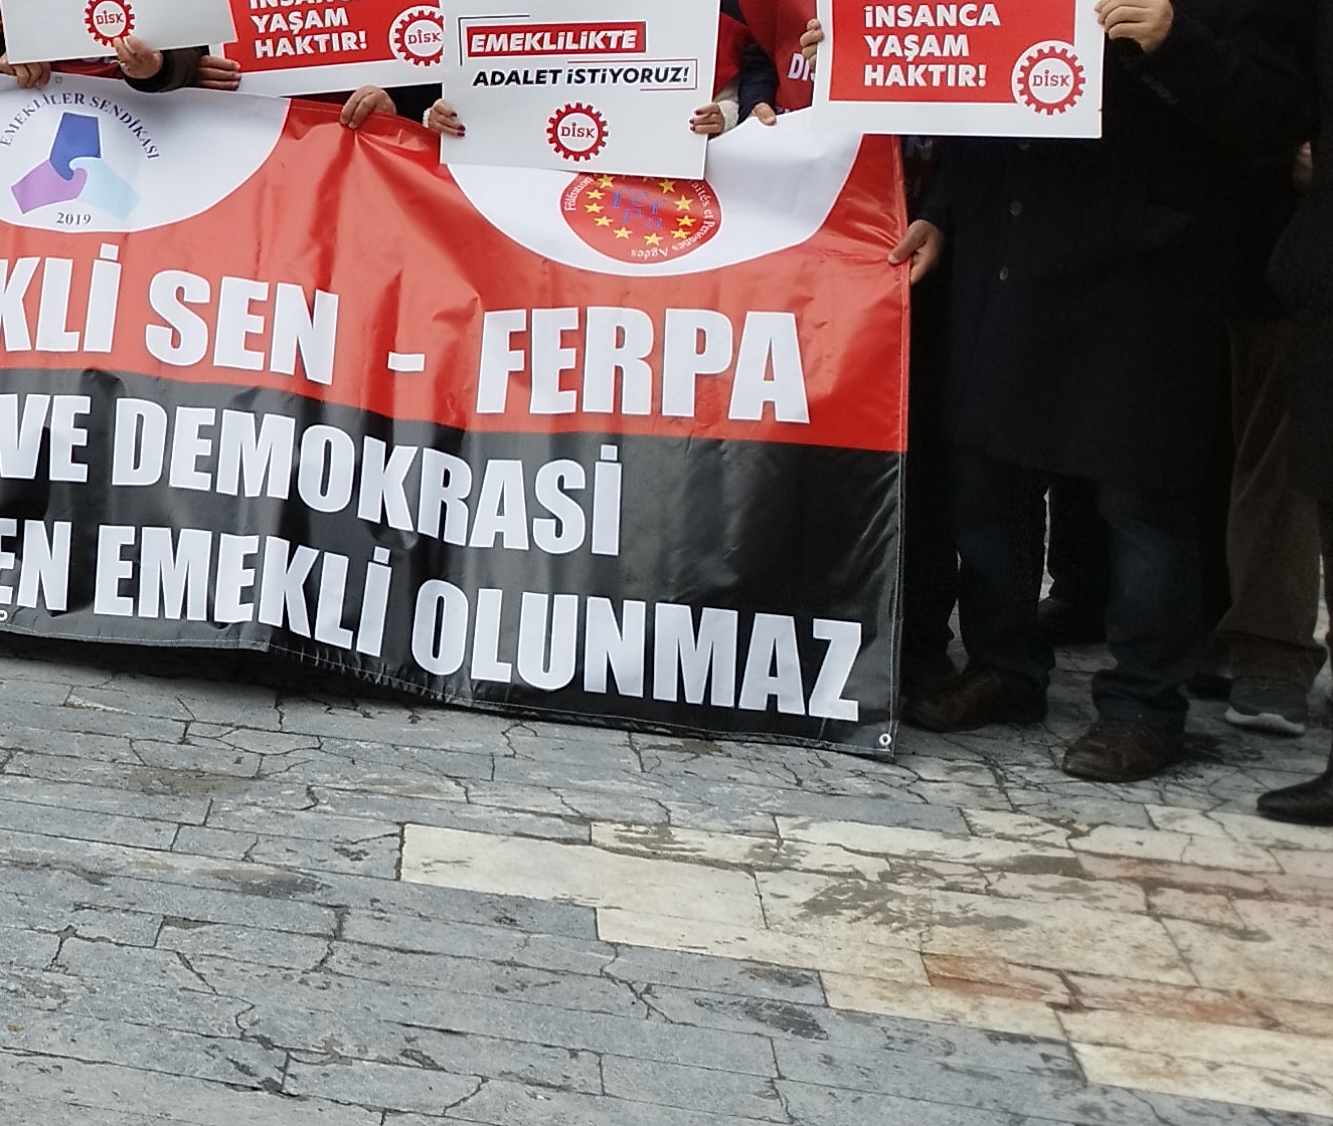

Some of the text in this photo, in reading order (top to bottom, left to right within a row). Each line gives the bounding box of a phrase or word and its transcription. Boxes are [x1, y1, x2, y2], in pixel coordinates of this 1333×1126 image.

[96, 9, 125, 25] DİSK
[250, 8, 349, 35] YAŞAM
[864, 3, 1001, 28] İNSANCA
[255, 31, 368, 59] HAKTIR!
[408, 29, 442, 45] DİSK
[470, 29, 638, 53] EMEKLİLİKTE
[863, 34, 969, 62] YAŞAM
[472, 66, 690, 87] ADALET İSTİYORUZ!
[863, 64, 987, 87] HAKTIR!
[1032, 69, 1071, 88] DİSK
[0, 92, 161, 161] EMEKLİLER SENDİKASI
[560, 121, 596, 139] DİSK
[56, 212, 92, 226] 2019
[145, 269, 339, 386] SEN
[387, 351, 425, 373] -
[475, 306, 810, 424] FERPA
[111, 397, 623, 557] DEMOKRASİ
[93, 524, 393, 658] EMEKLİ
[411, 578, 862, 723] OLUNMAZ
